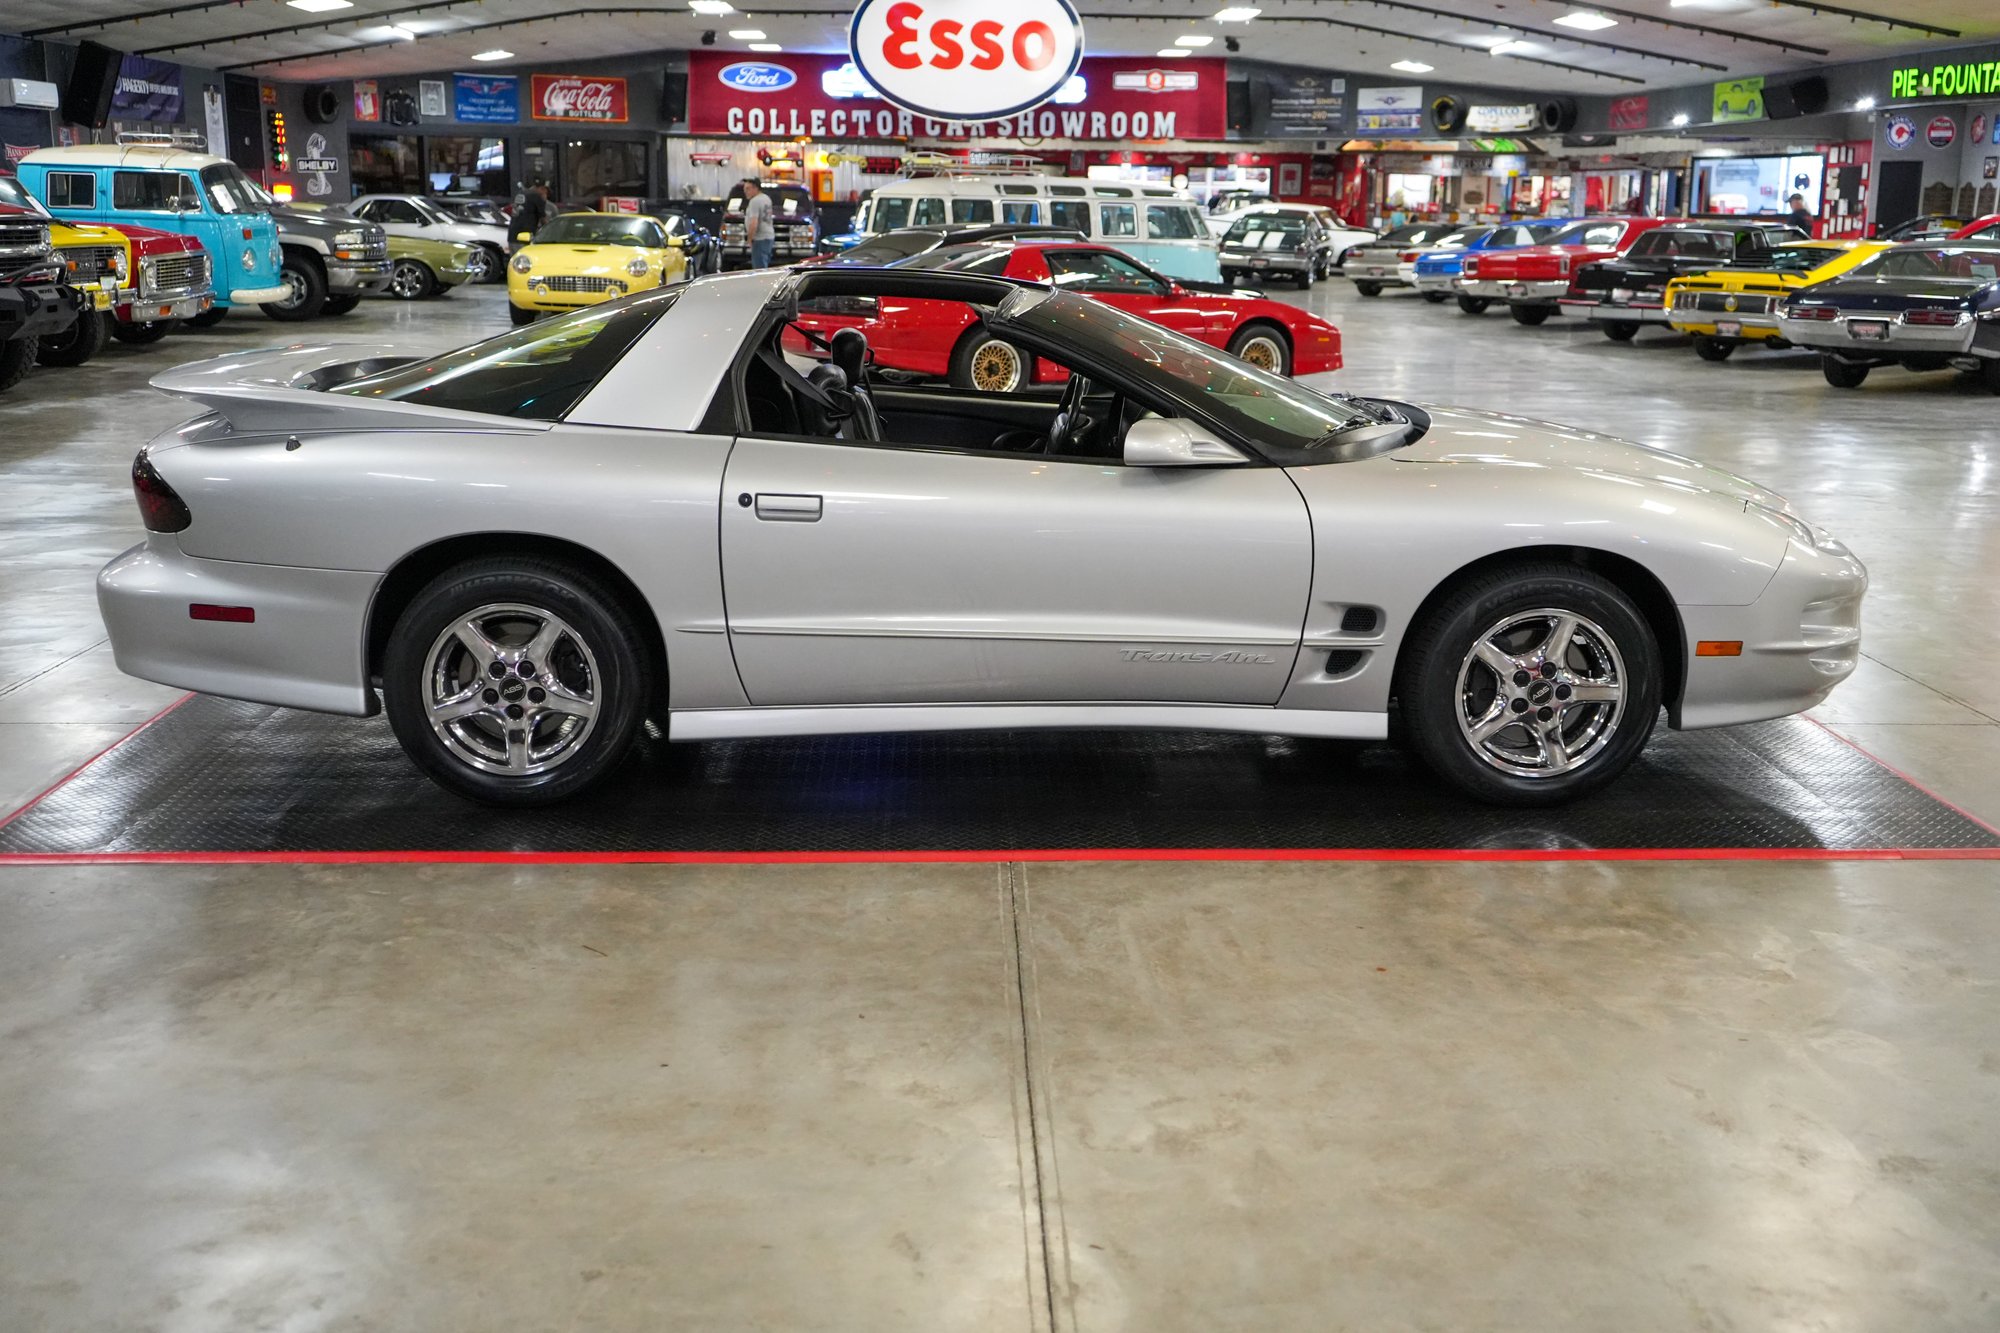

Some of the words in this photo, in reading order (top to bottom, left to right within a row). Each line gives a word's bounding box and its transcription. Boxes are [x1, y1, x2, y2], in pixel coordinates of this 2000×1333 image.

[882, 2, 1056, 71] Esso
[559, 79, 583, 87] DRINK
[735, 66, 779, 86] Ford
[1892, 68, 1919, 98] PIE
[122, 77, 149, 95] HAGERTY
[543, 81, 615, 111] Coca-Cola
[569, 110, 603, 118] BOTTLES
[727, 107, 914, 136] COLLECTOR
[997, 111, 1177, 138] SHOWROOM
[298, 160, 336, 170] SHELBY
[1120, 648, 1211, 663] Trans
[1211, 649, 1276, 665] Am
[1532, 685, 1550, 701] ABS
